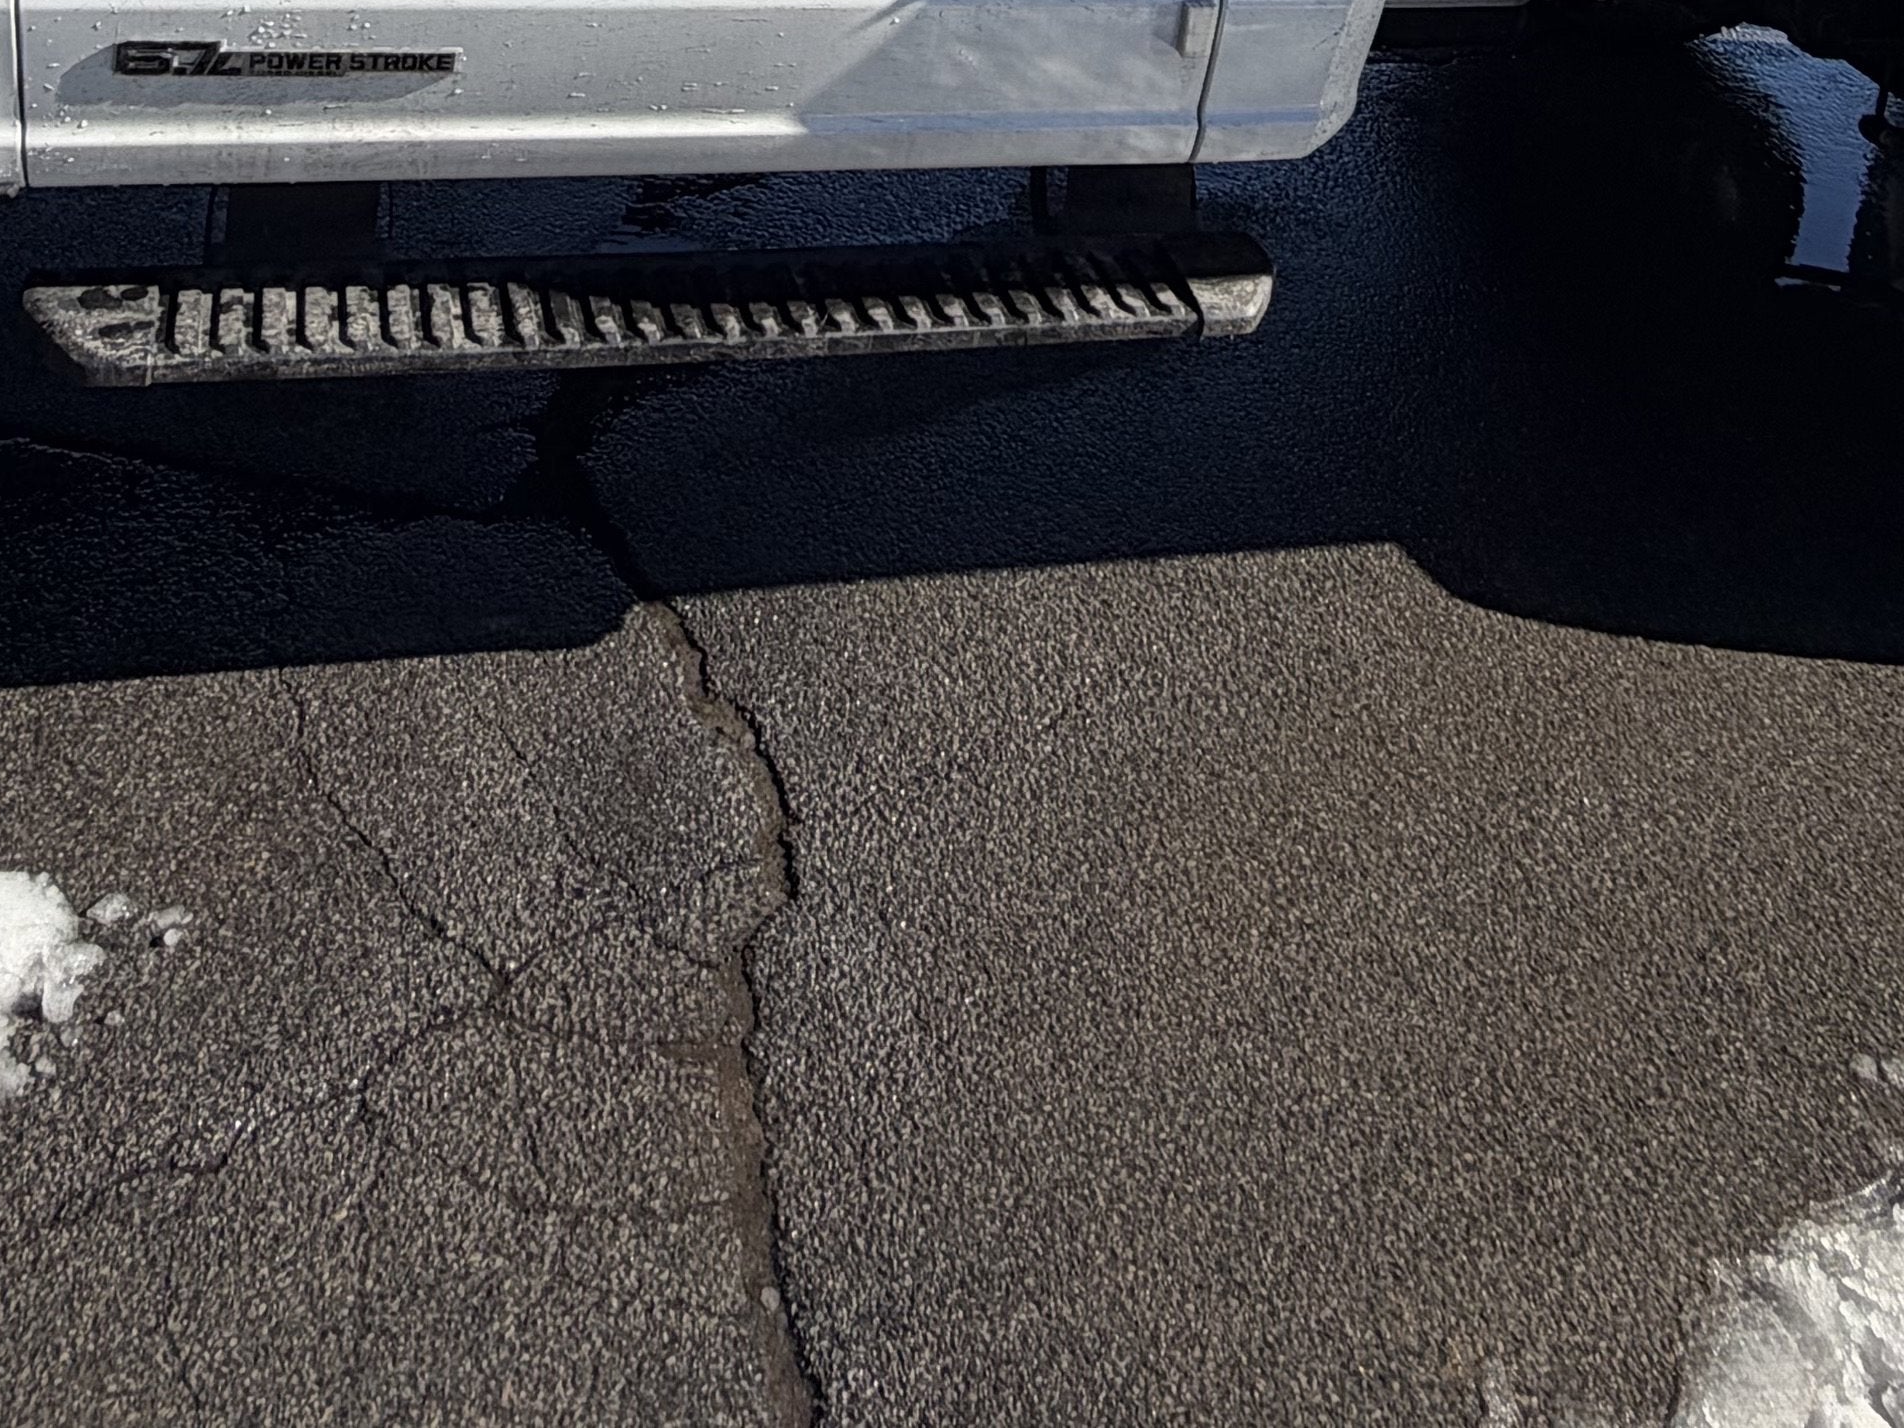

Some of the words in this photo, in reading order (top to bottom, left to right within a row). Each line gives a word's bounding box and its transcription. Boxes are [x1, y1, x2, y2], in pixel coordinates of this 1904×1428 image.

[115, 40, 242, 76] 6.7L
[249, 52, 341, 71] POWER
[349, 52, 452, 72] STROKE
